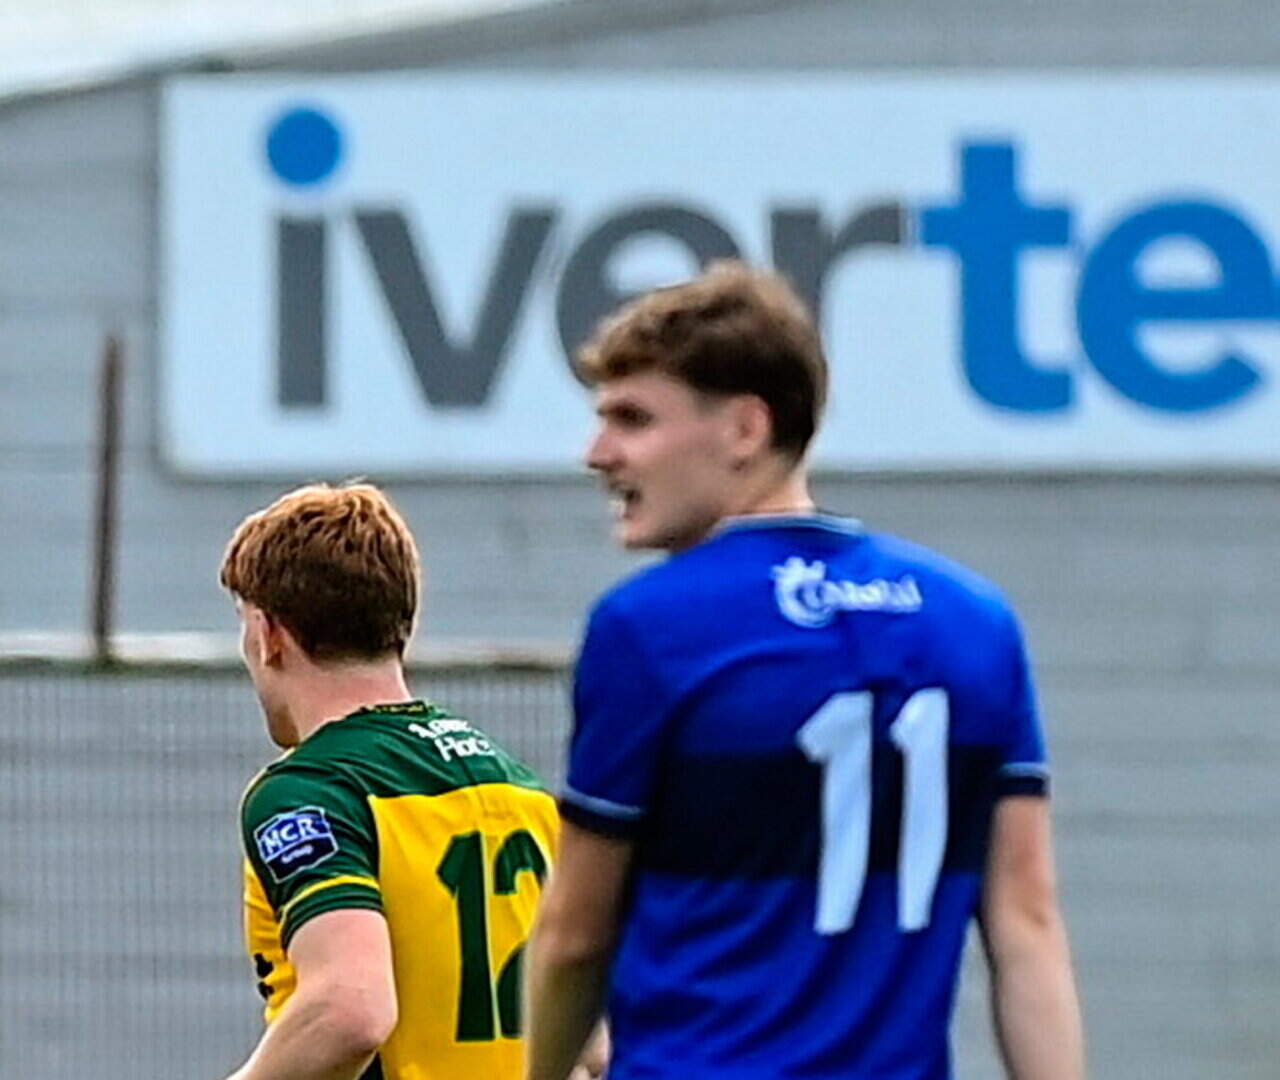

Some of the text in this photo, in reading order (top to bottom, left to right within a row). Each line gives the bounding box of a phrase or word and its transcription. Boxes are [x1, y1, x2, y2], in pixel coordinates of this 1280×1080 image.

[261, 817, 320, 854] MCR
[795, 687, 950, 936] 11
[435, 828, 548, 1043] 12
